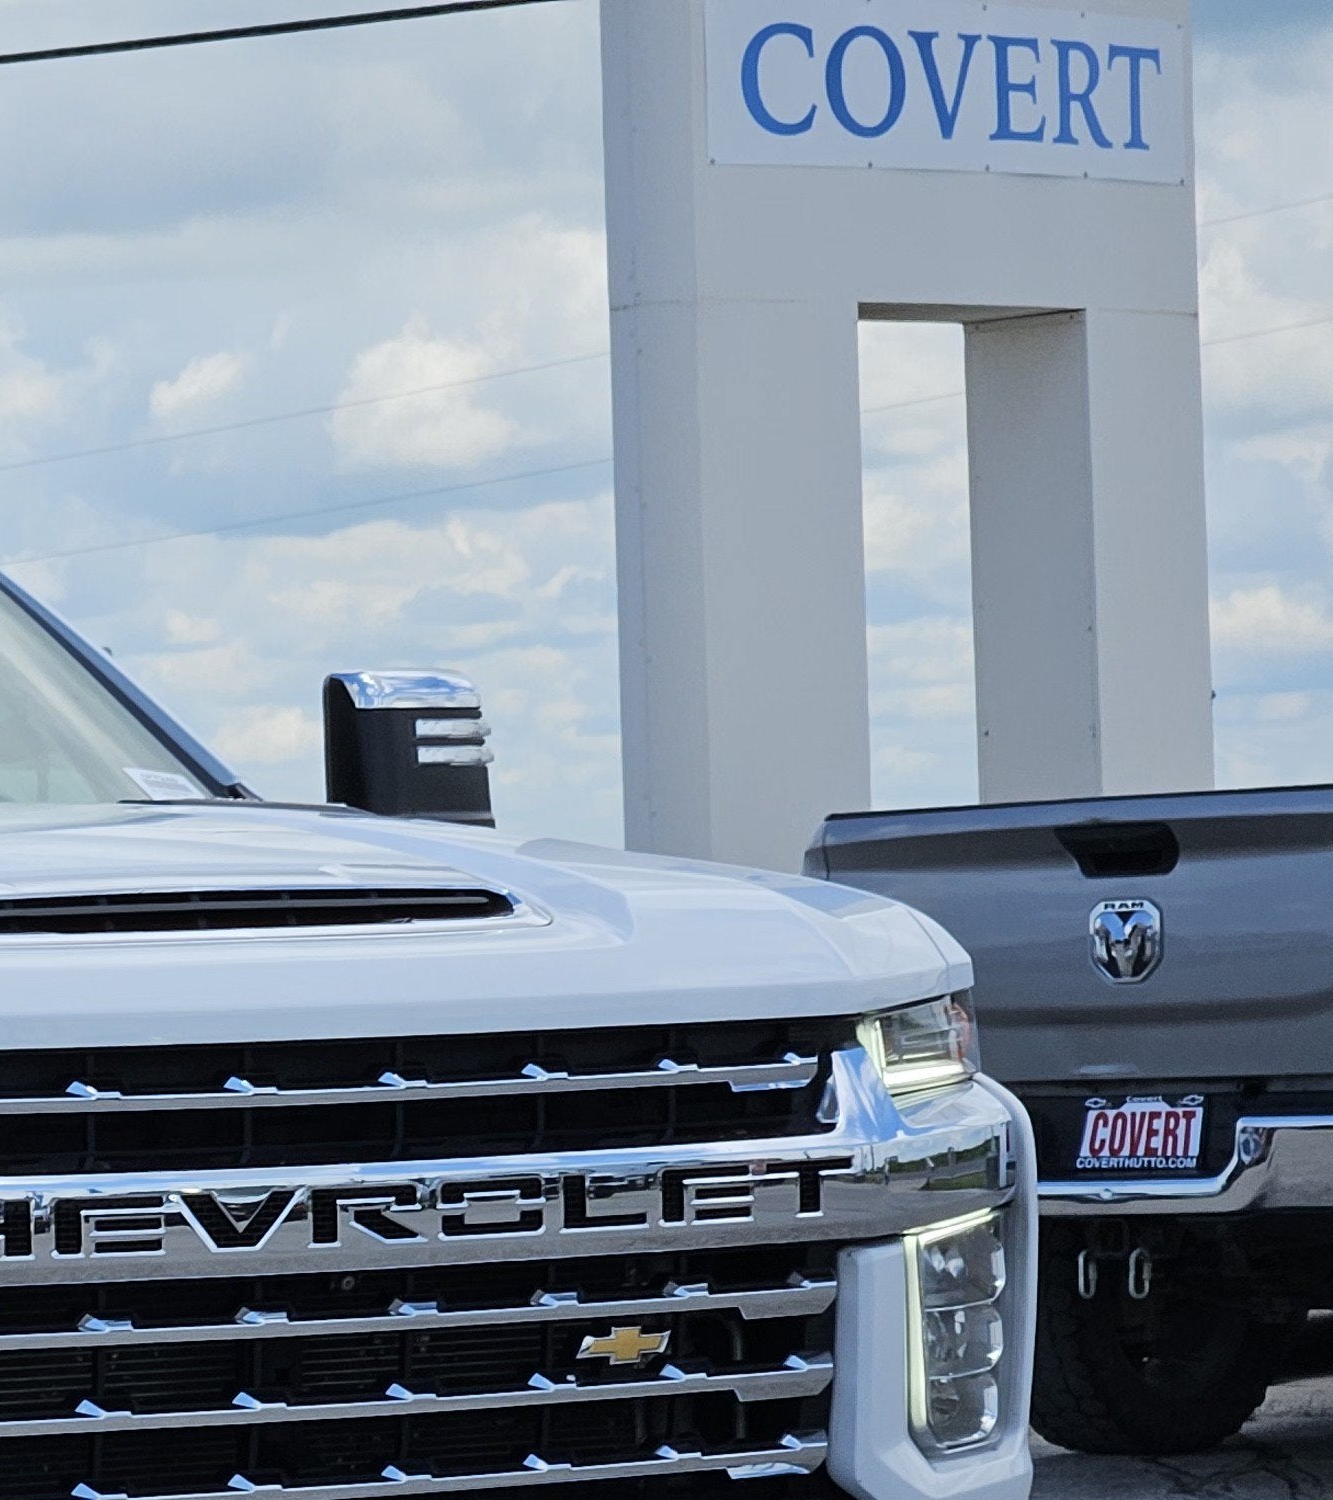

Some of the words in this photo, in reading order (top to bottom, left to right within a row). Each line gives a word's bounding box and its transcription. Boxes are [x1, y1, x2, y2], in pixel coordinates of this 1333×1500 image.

[741, 21, 1162, 151] COVERT
[1103, 902, 1144, 910] RAM
[1089, 1110, 1196, 1157] COVERT
[1076, 1157, 1197, 1169] COVERTHUTTO.COM
